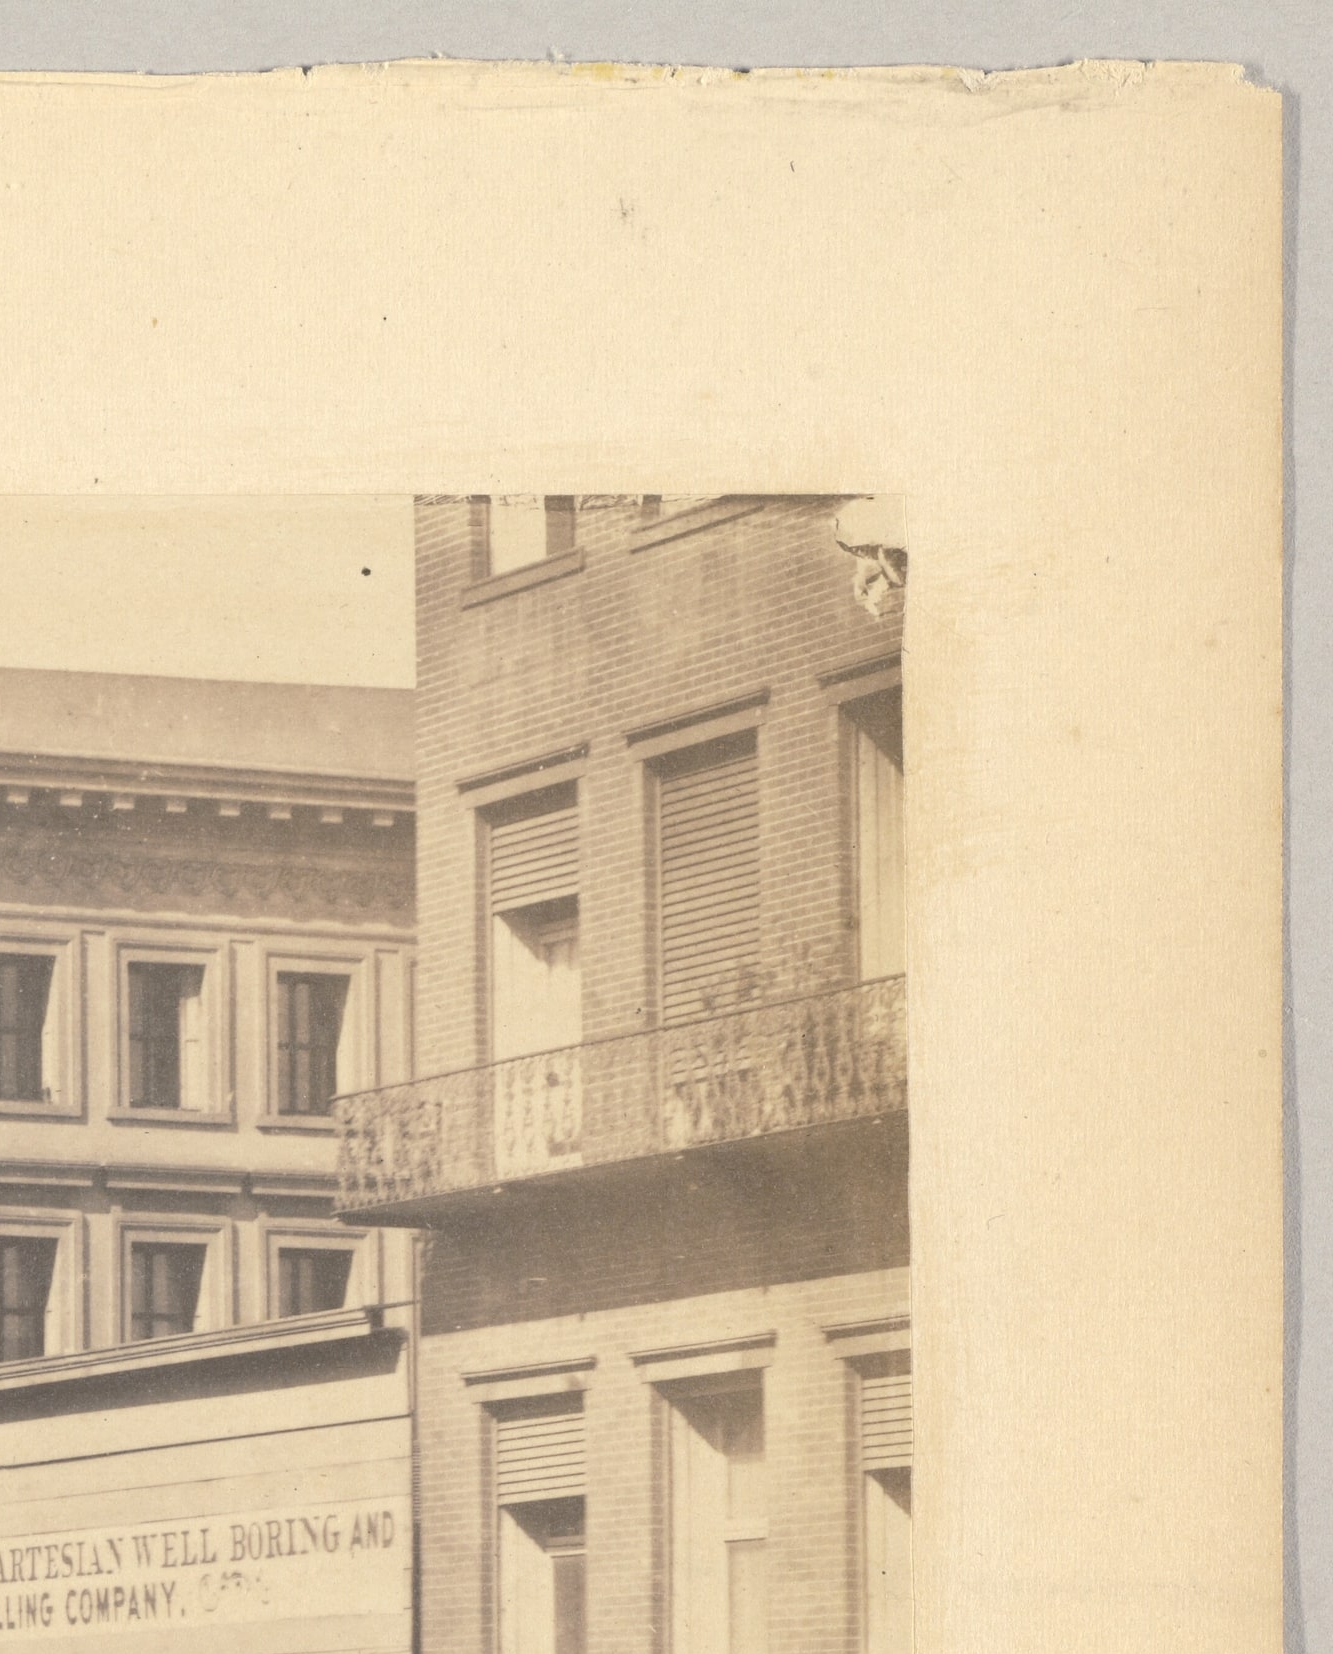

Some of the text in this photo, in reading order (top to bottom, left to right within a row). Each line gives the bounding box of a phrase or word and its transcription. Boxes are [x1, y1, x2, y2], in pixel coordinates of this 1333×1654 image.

[132, 1528, 217, 1569] WELL
[229, 1514, 341, 1562] BORING
[350, 1510, 395, 1550] AND
